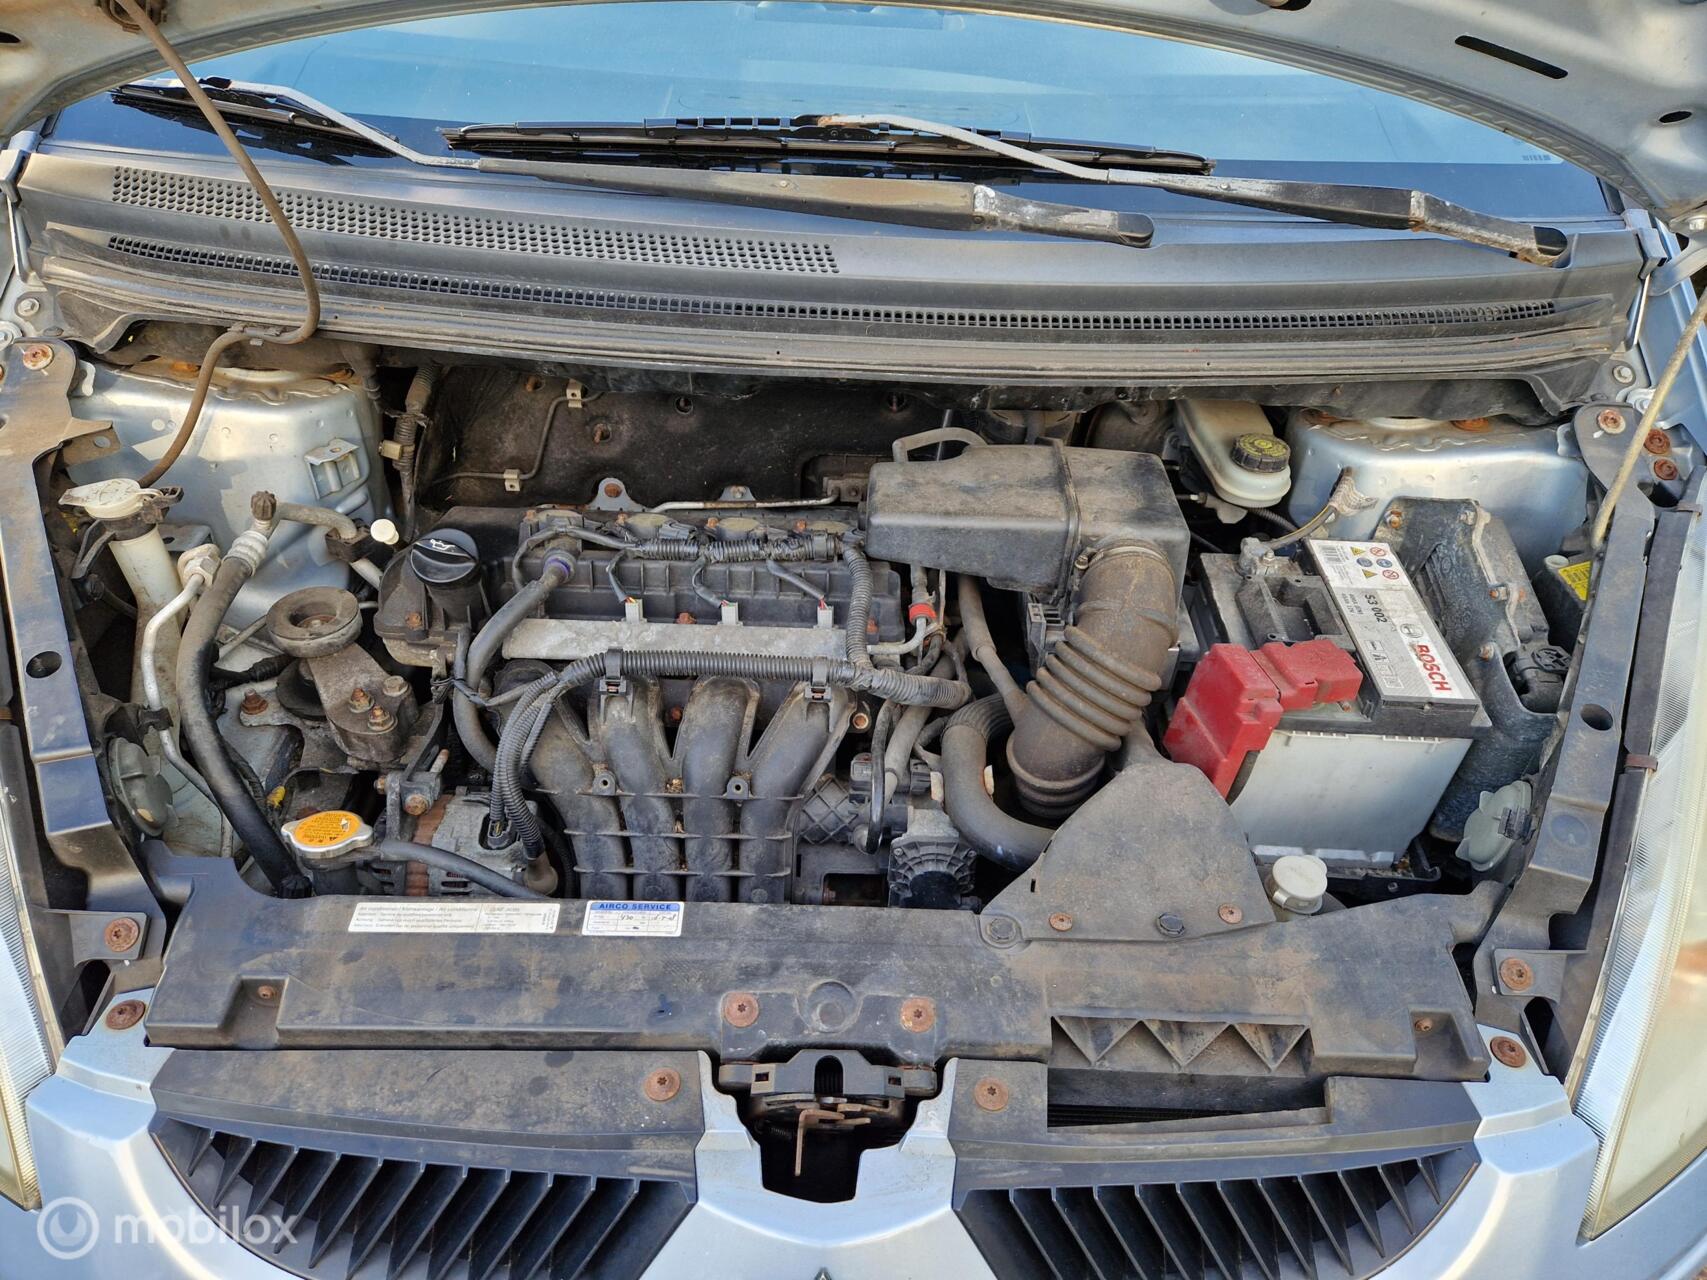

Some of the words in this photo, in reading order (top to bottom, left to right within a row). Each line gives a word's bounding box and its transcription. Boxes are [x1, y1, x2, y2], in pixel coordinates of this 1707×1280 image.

[1364, 594, 1378, 605] S3
[1371, 607, 1388, 623] 002
[1416, 644, 1452, 692] BOSCH
